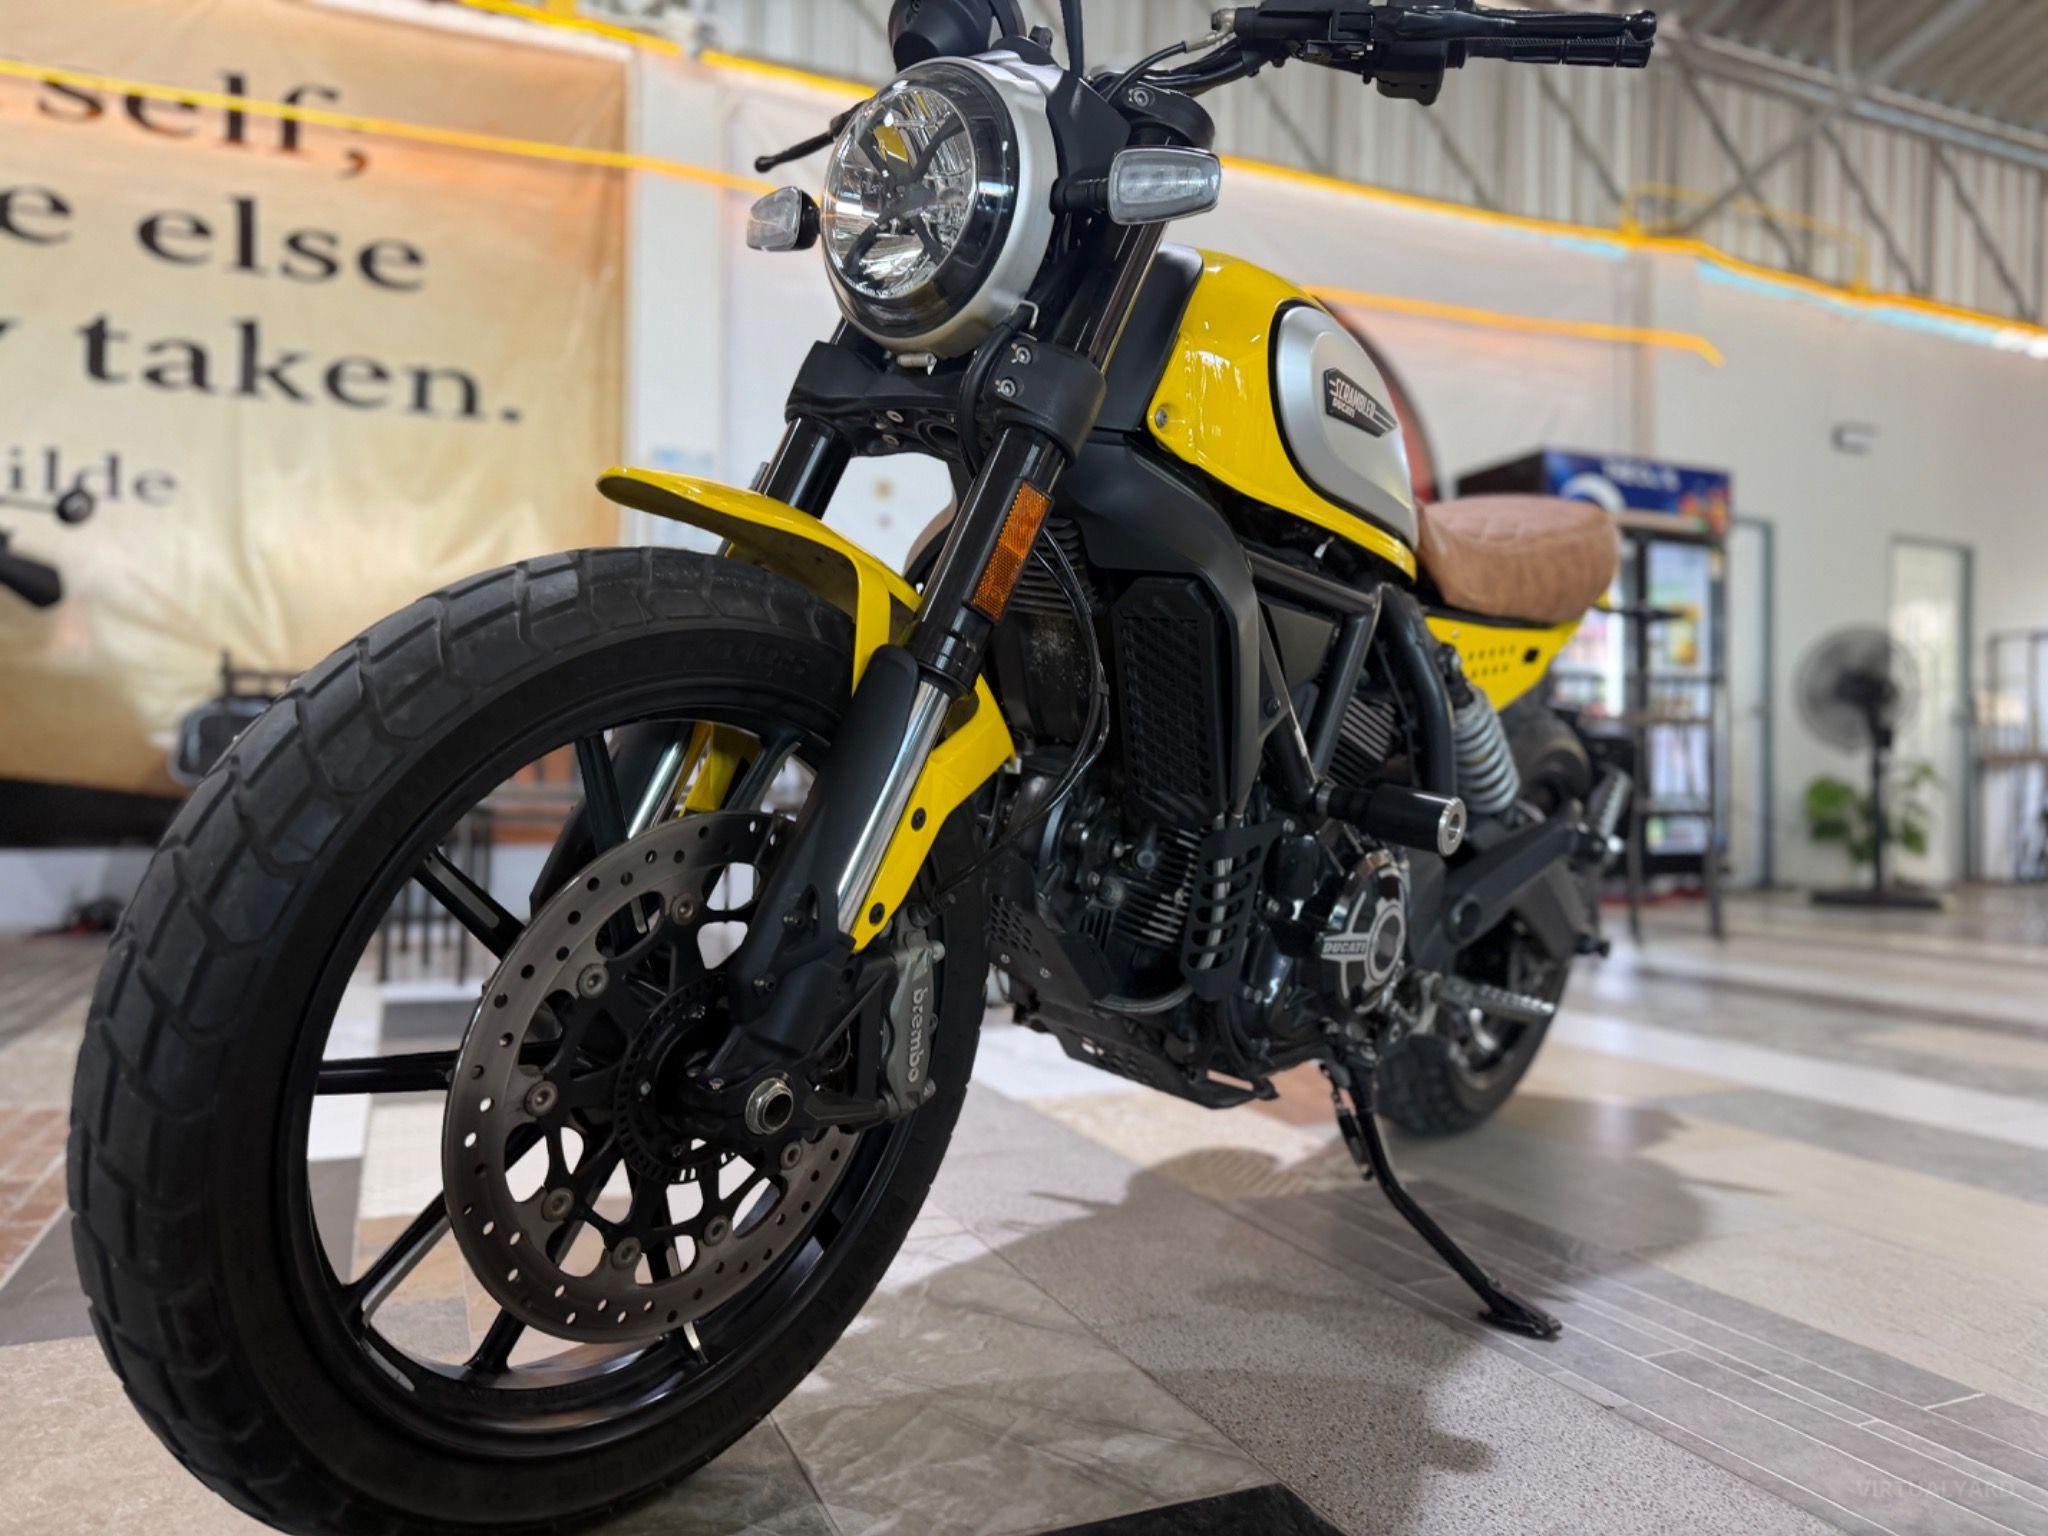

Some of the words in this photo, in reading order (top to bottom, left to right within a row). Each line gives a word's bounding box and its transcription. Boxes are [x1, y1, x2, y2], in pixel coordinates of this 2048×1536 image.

[135, 195, 426, 293] else
[76, 312, 523, 424] taken.
[1322, 941, 1368, 954] DUCATI
[908, 986, 929, 1083] brembo
